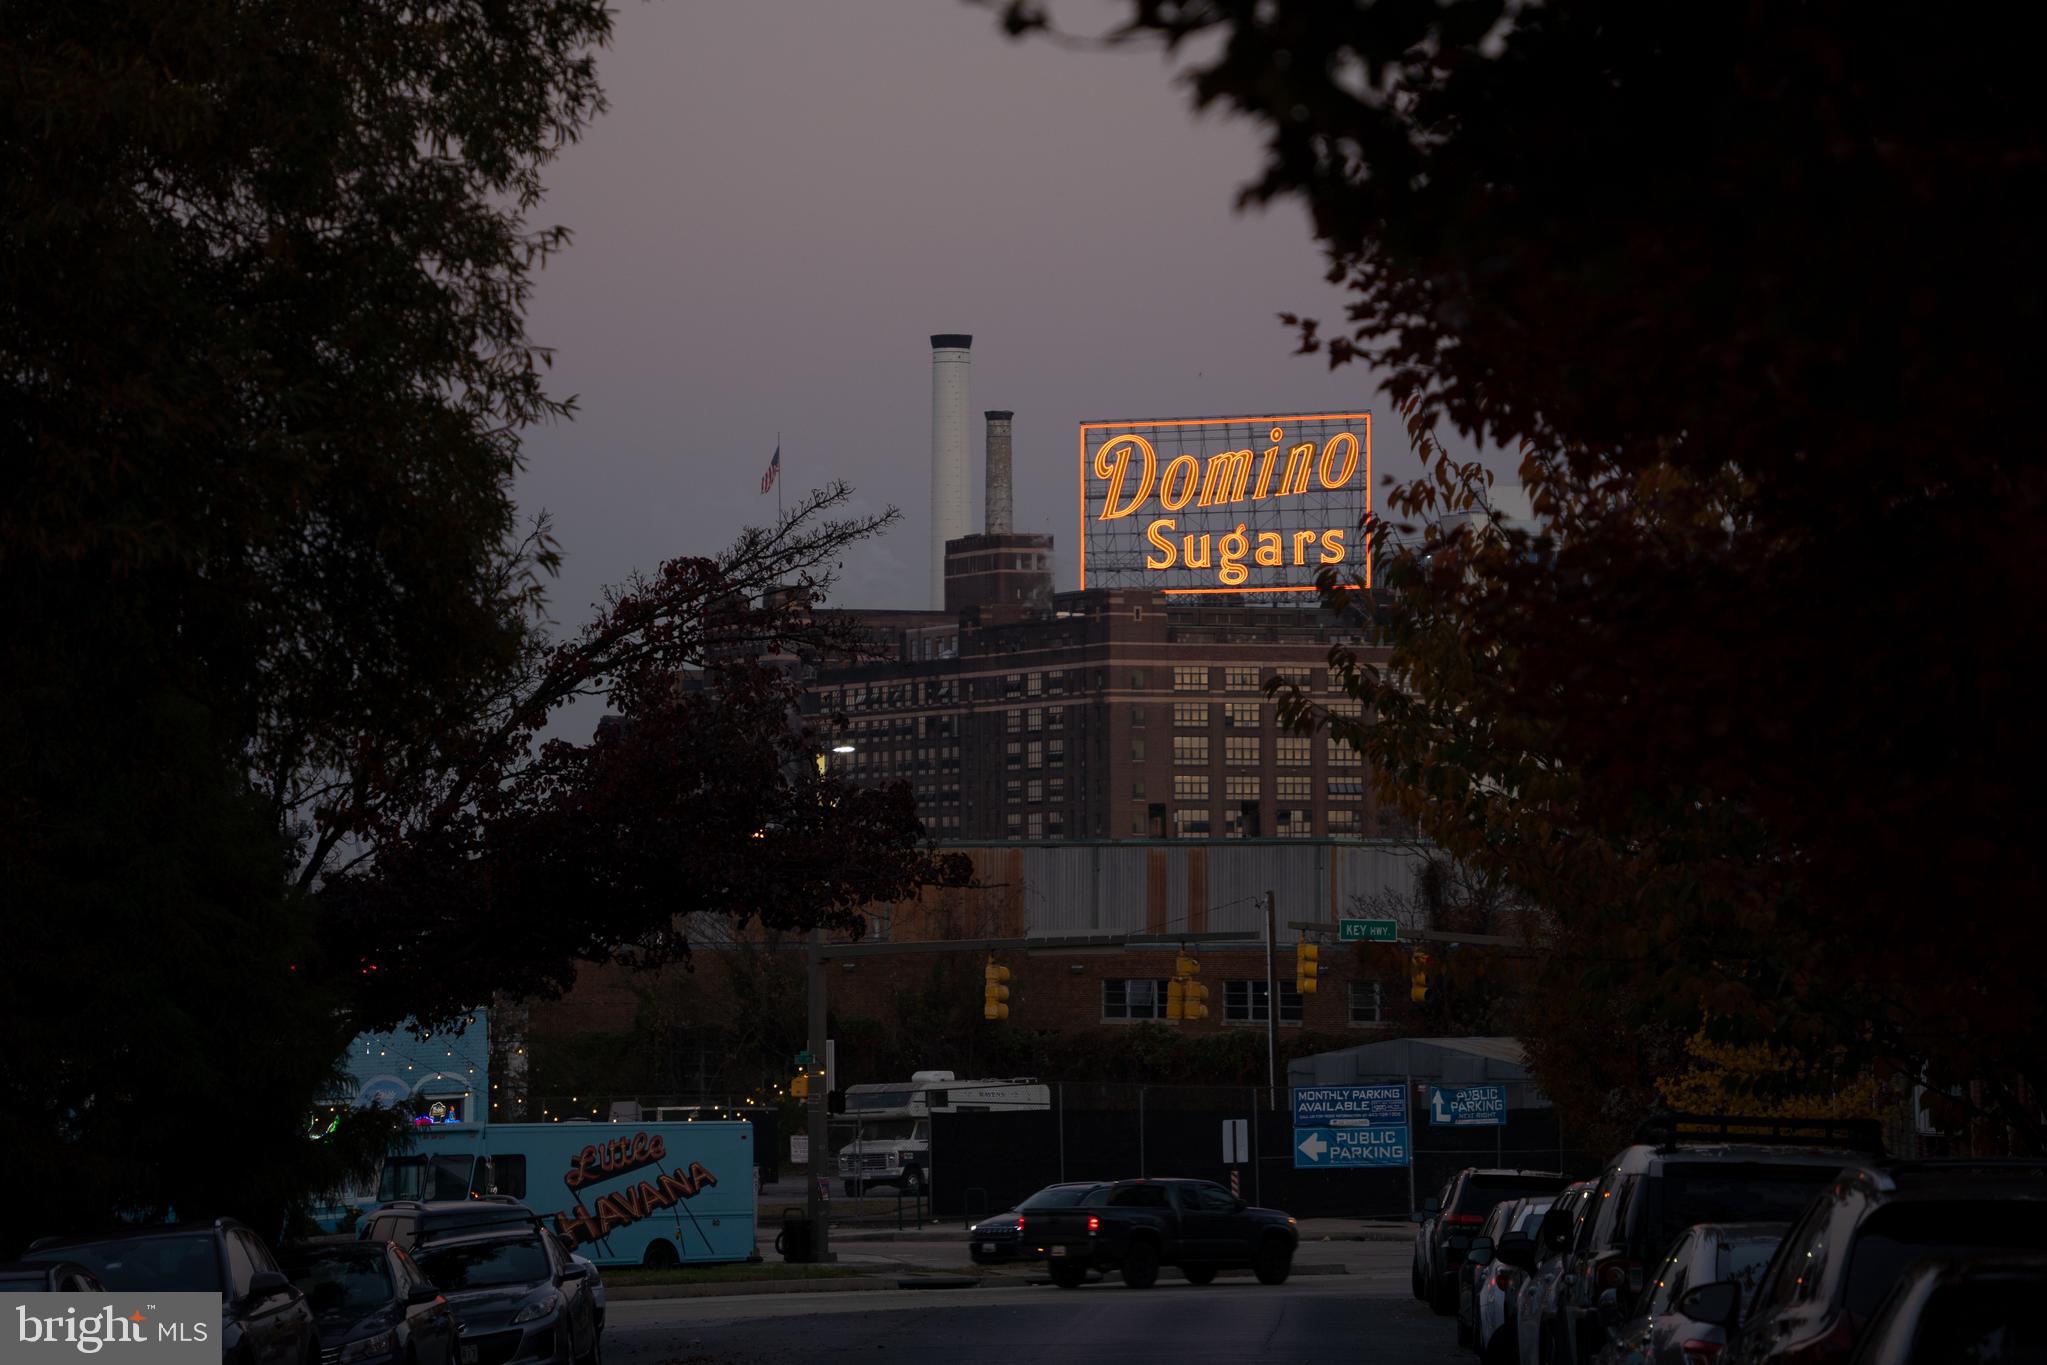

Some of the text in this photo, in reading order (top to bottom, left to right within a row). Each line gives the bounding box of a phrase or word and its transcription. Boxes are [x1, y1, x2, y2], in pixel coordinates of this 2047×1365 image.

[1094, 427, 1360, 521] Domino
[1147, 518, 1346, 586] Sugars
[1346, 924, 1367, 936] KEY
[1298, 1088, 1400, 1101] MONTHLY PARKING
[1456, 1088, 1498, 1102] PUBLIC
[1298, 1101, 1370, 1112] AVAILABLE
[1450, 1100, 1503, 1112] PARKING
[1336, 1131, 1396, 1145] PUBLIC
[1330, 1146, 1404, 1160] PARKING
[565, 1132, 666, 1190] Little
[554, 1162, 718, 1250] HAVANA
